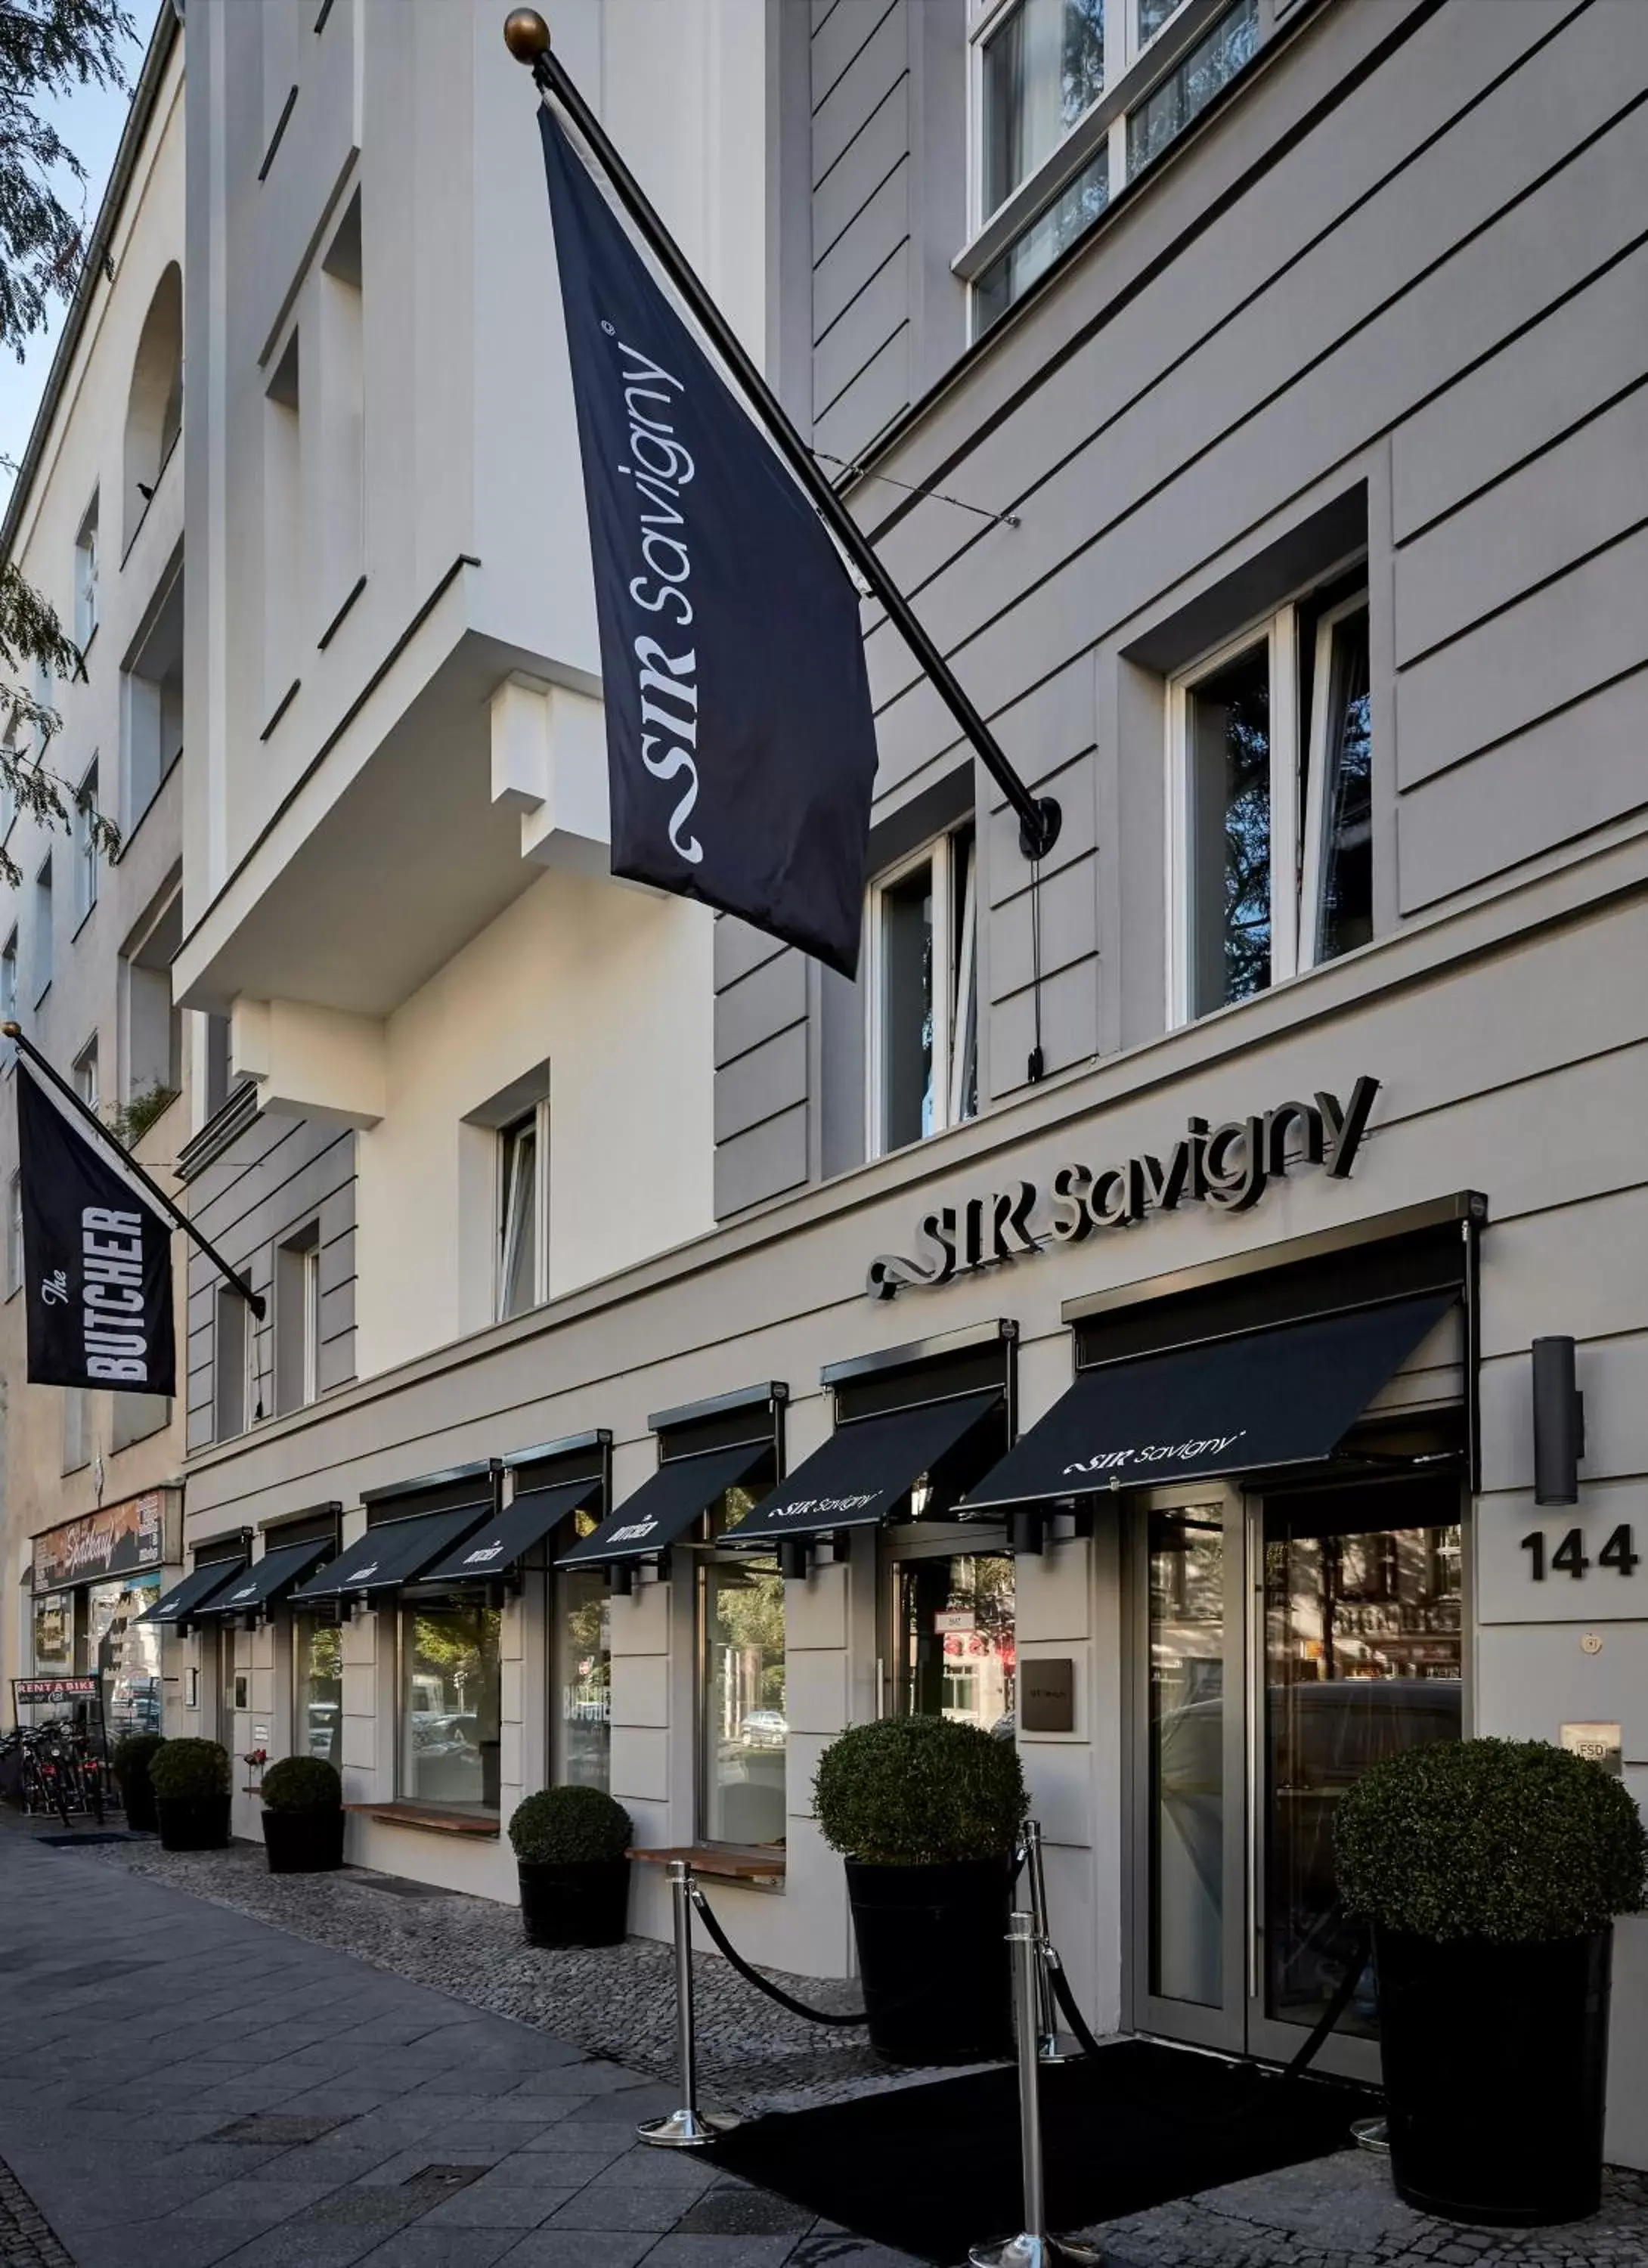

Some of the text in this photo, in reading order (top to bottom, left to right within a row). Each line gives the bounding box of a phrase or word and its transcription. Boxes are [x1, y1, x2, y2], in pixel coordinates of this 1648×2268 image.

[617, 341, 703, 864] SIR Savigny
[866, 1074, 1383, 1300] SIR Savigny
[41, 1269, 70, 1306] The
[81, 1207, 147, 1382] BUTCHER
[1063, 1436, 1238, 1475] SIR Savigny
[1520, 1523, 1640, 1582] 144
[17, 1681, 95, 1693] RENT A BIKE
[1579, 1744, 1603, 1756] FSD
